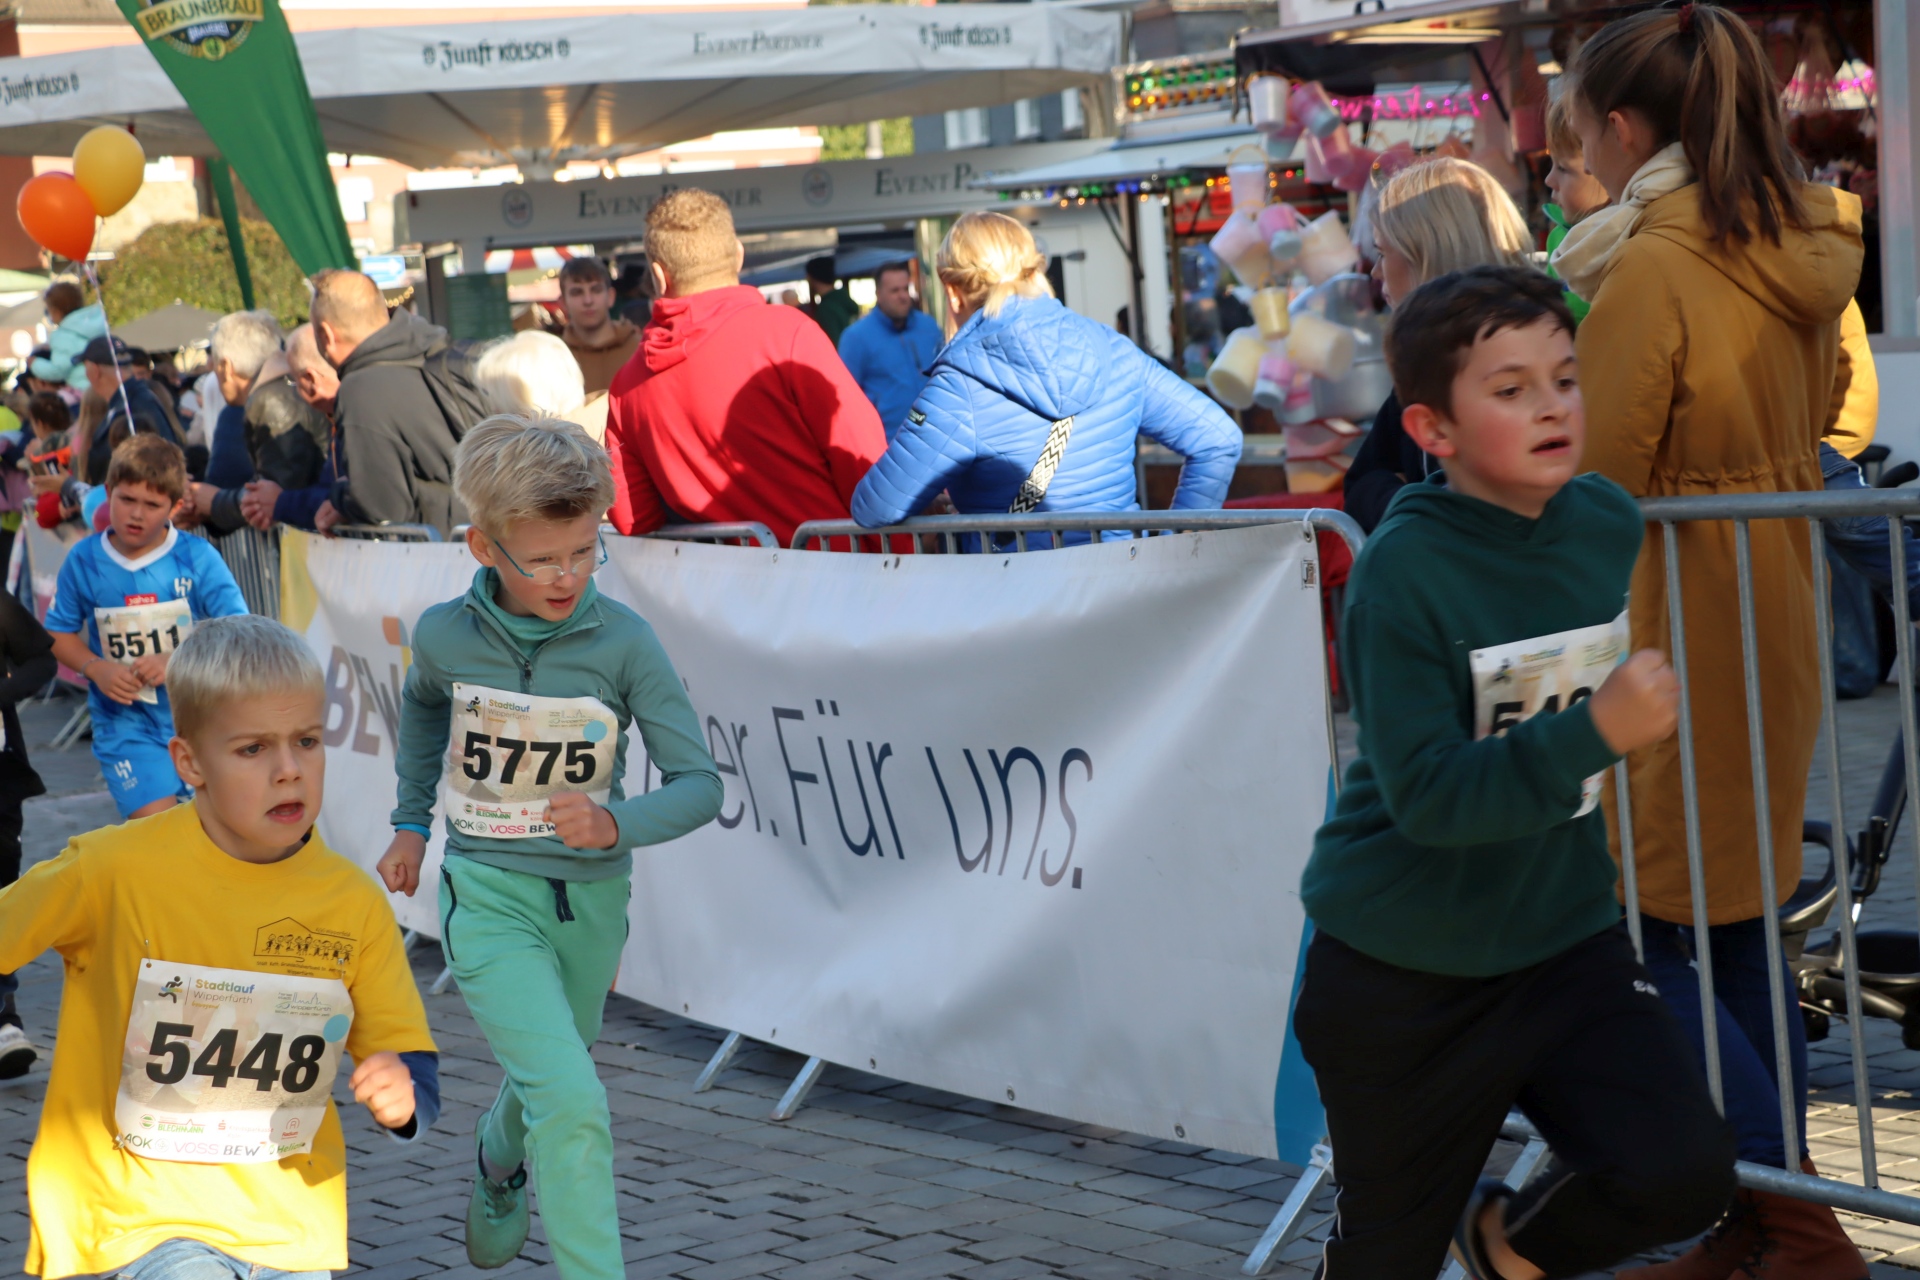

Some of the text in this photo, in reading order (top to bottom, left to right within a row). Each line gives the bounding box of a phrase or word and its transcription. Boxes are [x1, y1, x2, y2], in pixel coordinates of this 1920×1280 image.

[498, 38, 554, 63] KÖLSCH
[107, 624, 180, 660] 5511
[487, 708, 531, 722] Wipperfürth
[488, 698, 531, 713] Stadtlauf
[462, 730, 597, 786] 5775
[454, 818, 475, 831] AOK
[489, 824, 526, 835] VOSS
[924, 745, 1094, 890] uns.
[192, 989, 254, 1005] Wipperfürth
[194, 978, 256, 995] Stadtlauf
[145, 1021, 326, 1094] 5448
[157, 1123, 204, 1134] BLECHMANN
[124, 1132, 261, 1157] AOK VOSS BEW
